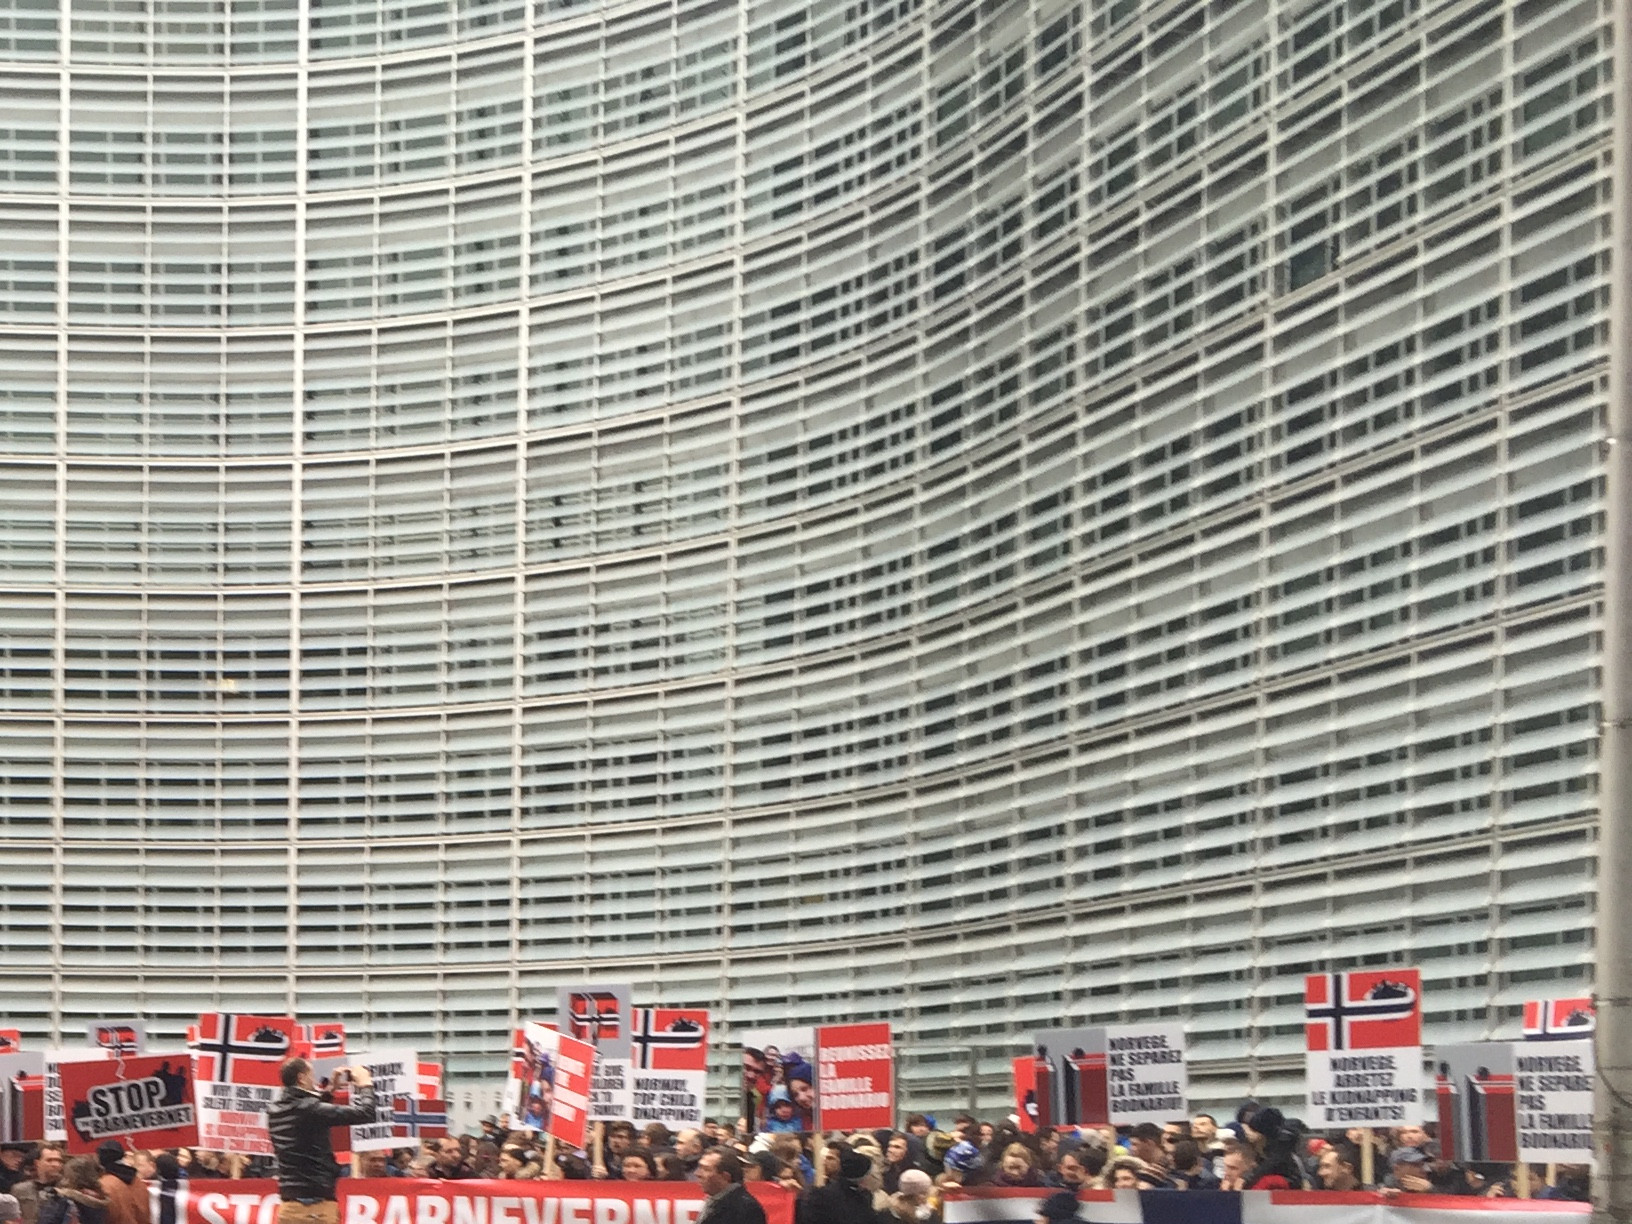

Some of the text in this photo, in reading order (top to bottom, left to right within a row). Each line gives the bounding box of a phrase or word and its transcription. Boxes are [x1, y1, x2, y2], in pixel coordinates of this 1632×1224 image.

[1110, 1068, 1135, 1082] PAS
[1111, 1084, 1126, 1098] LA
[91, 1080, 161, 1118] STOP
[633, 1092, 657, 1105] TOP
[1519, 1094, 1546, 1111] PAS
[632, 1106, 701, 1121] DNAPPING!
